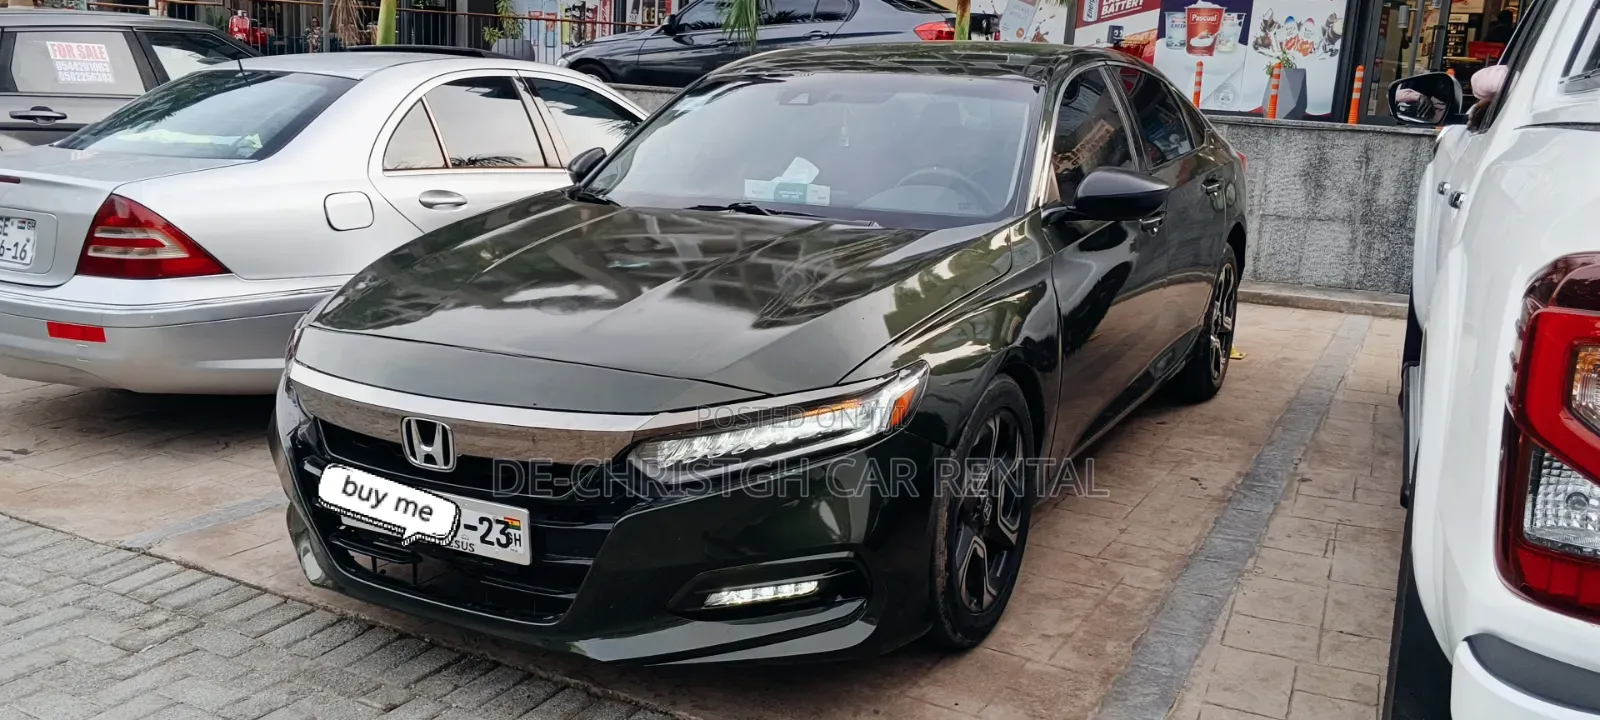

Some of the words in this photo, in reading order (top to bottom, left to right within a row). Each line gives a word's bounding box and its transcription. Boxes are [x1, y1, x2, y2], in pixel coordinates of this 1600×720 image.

[1191, 13, 1218, 22] Pascual
[50, 43, 76, 59] FOR
[76, 44, 107, 61] SALE
